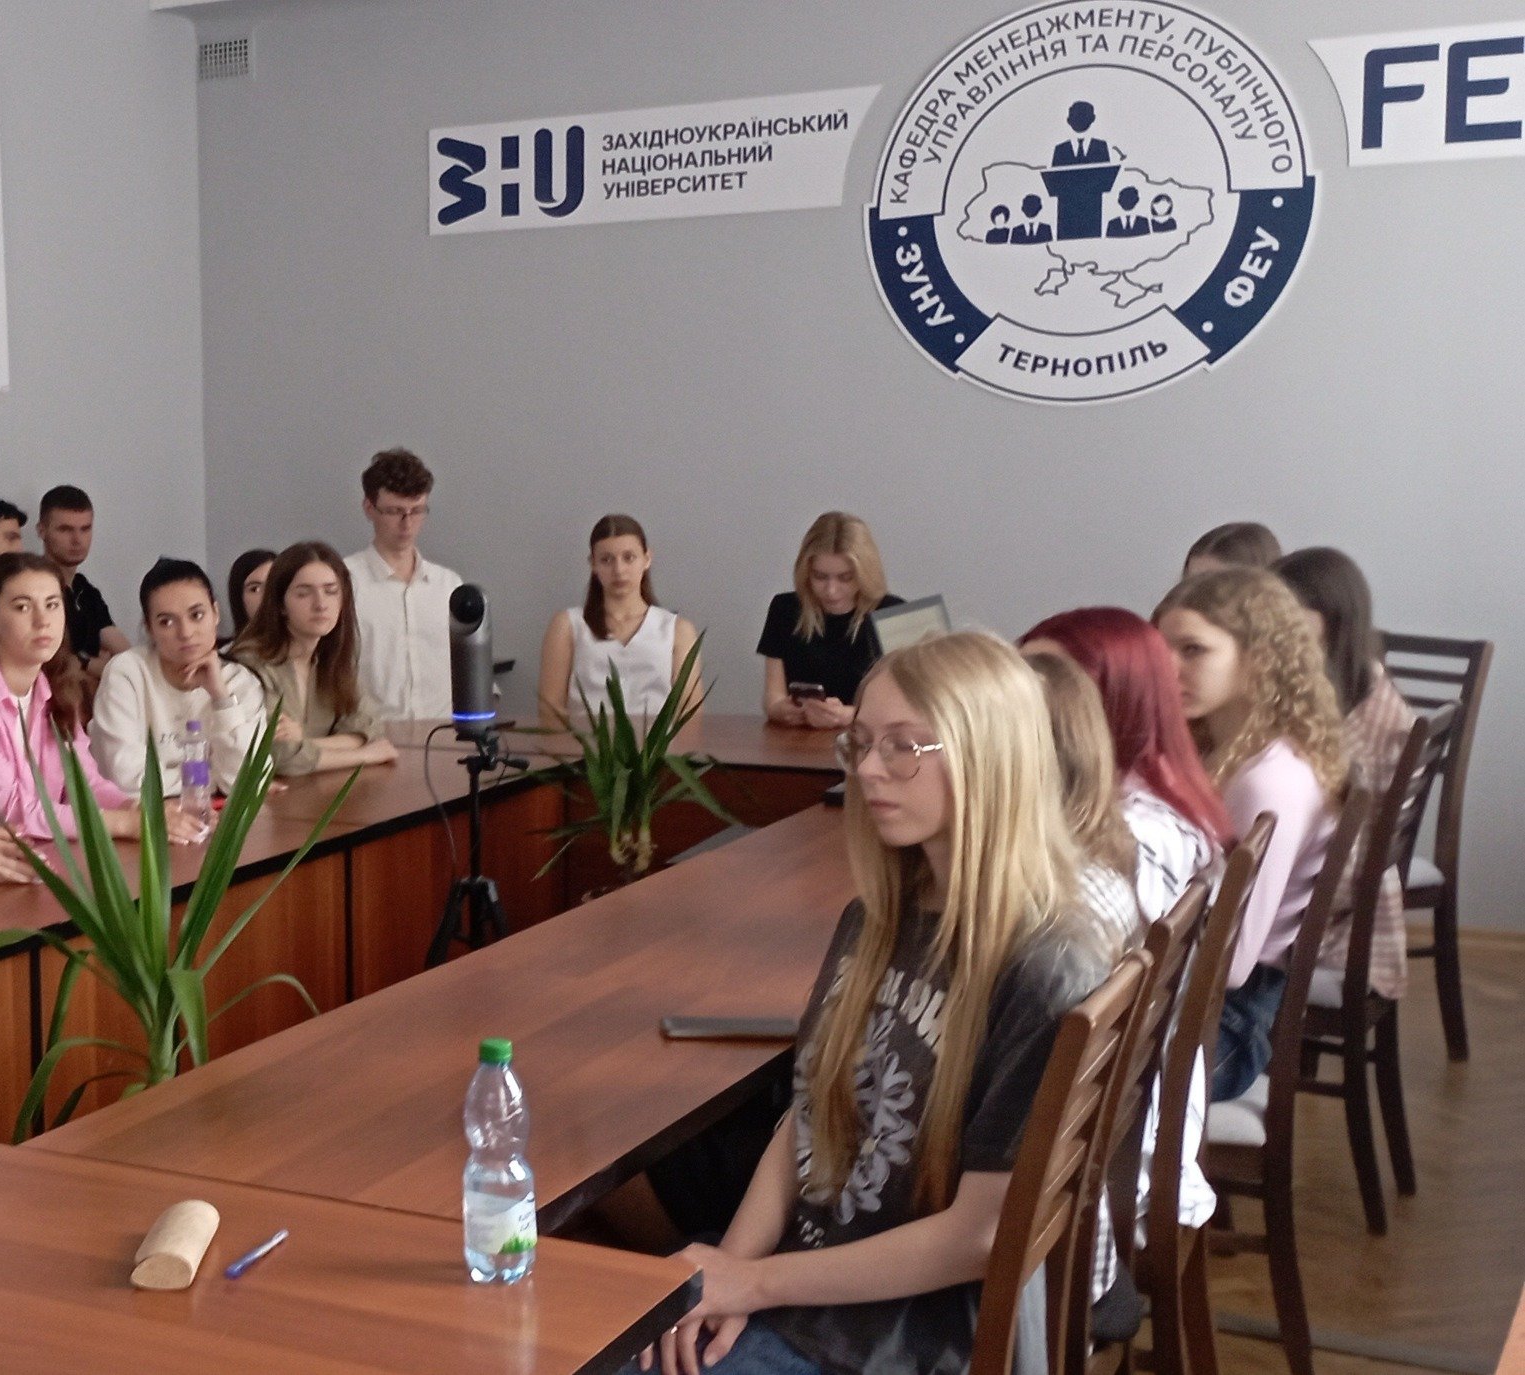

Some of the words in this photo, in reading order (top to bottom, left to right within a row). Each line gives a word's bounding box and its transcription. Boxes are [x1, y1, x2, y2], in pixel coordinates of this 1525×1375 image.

[601, 109, 850, 151] ЗАХІДНОУКРАЇНСЬКИЙ
[890, 86, 956, 204] КАФЕДРА
[953, 8, 1176, 86] МЕНЕДЖМЕНТУ,
[1183, 26, 1293, 174] ПУБЛІЧНОГО
[923, 41, 1068, 165] УПРАВЛІННЯ
[1076, 34, 1110, 55] ТА
[1118, 34, 1258, 143] ПЕРСОНАЛУ
[601, 141, 774, 176] НАЦІОНАЛЬНИЙ
[602, 171, 748, 200] УНІВЕРСИТЕТ
[896, 243, 955, 328] ЗУНУ
[1224, 226, 1280, 307] ФЕУ
[996, 338, 1169, 377] ТЕРНОПІЛЬ
